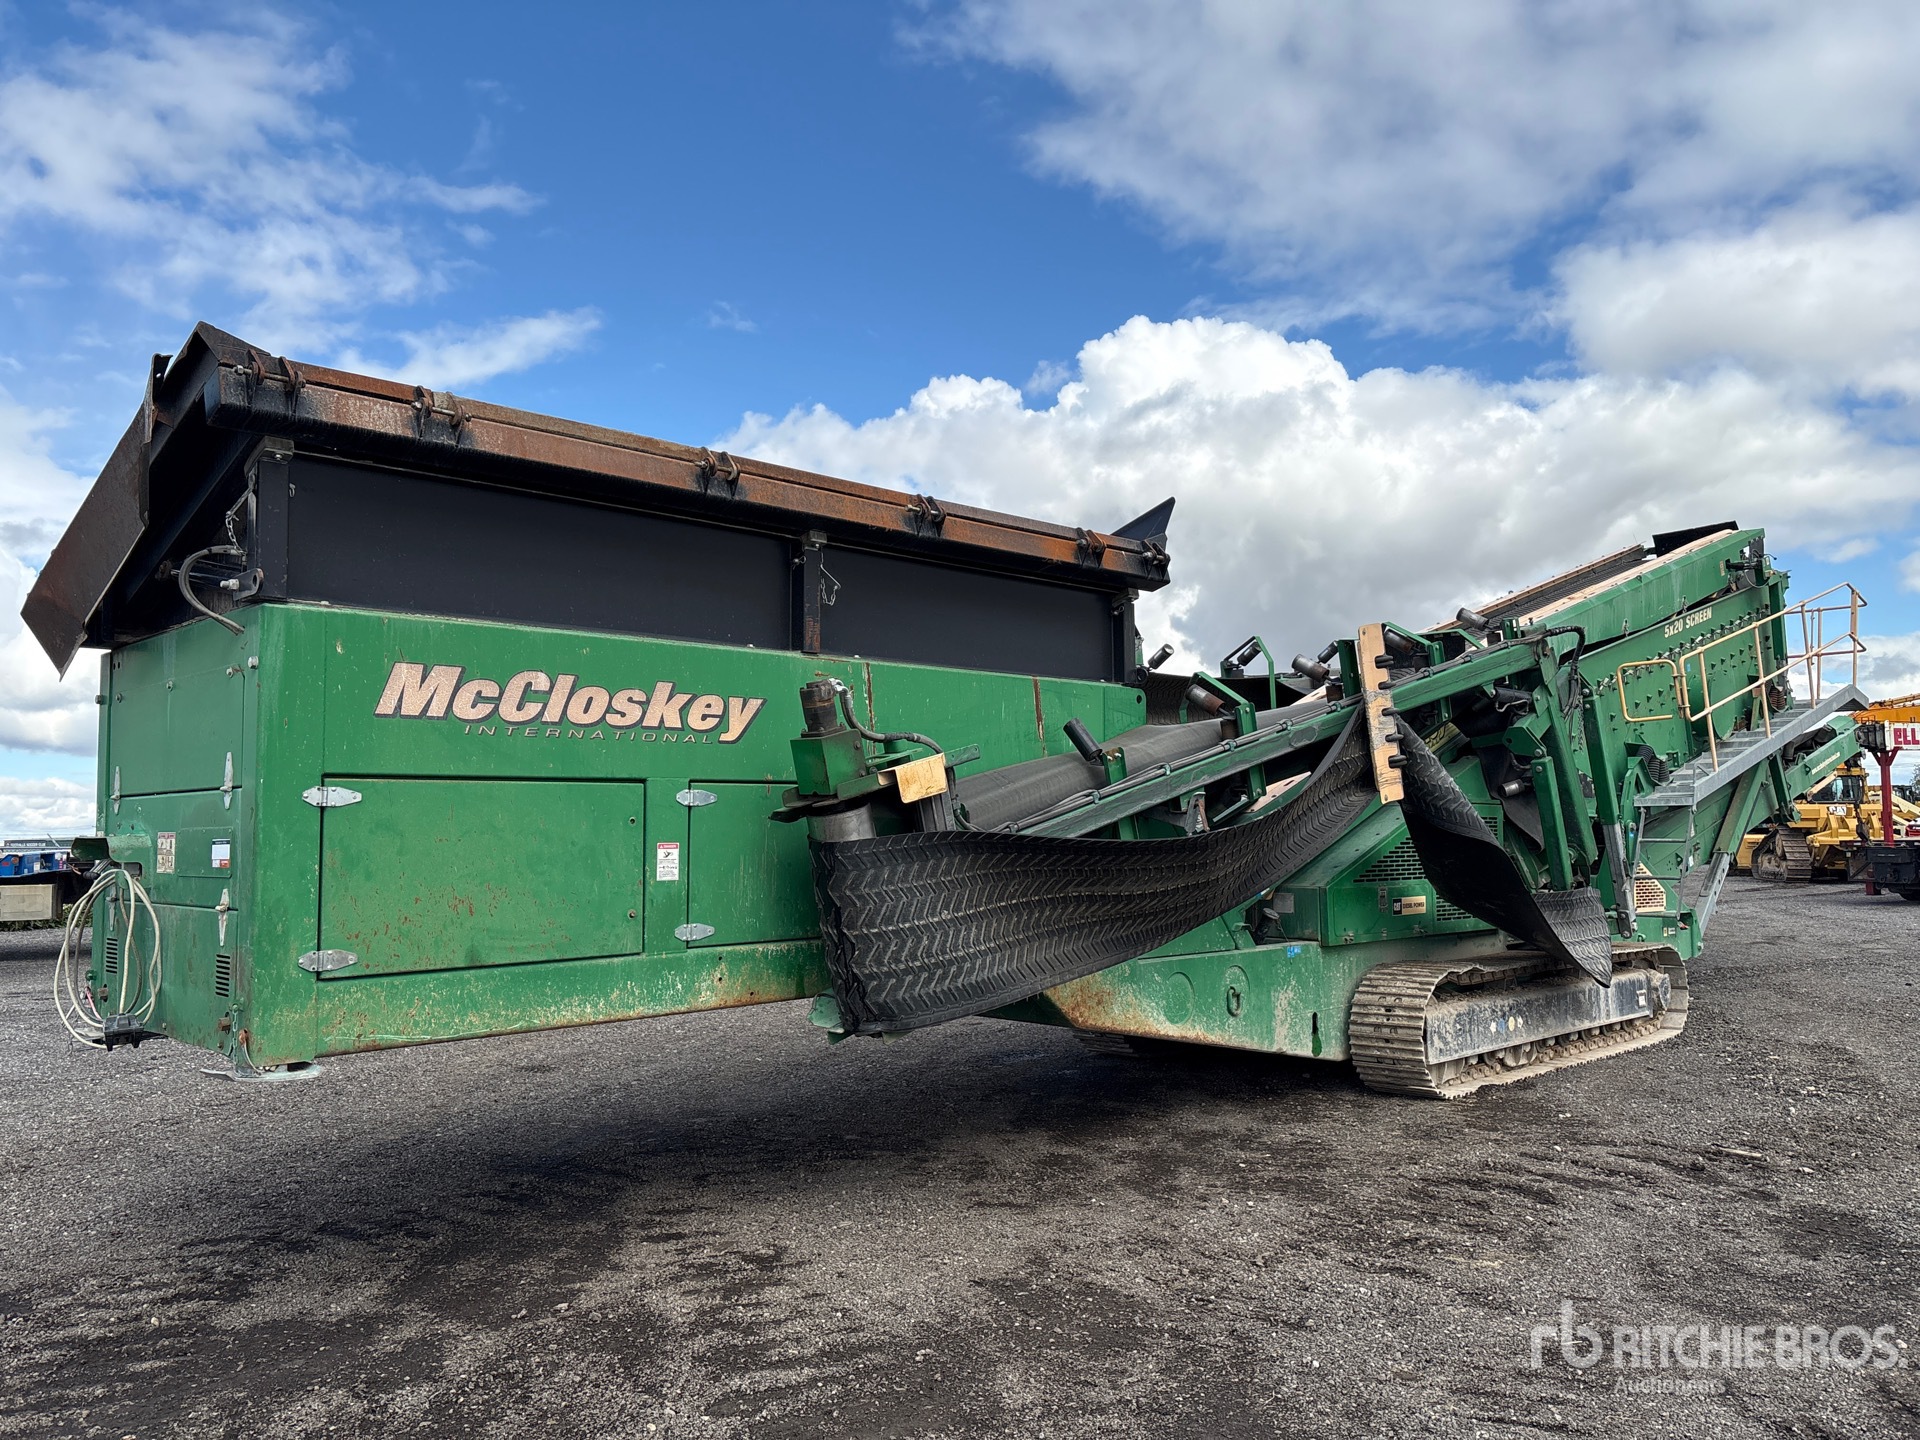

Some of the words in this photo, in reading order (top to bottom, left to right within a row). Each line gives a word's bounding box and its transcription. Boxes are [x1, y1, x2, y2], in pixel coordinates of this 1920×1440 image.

[1664, 618, 1684, 638] 5x20
[1686, 606, 1712, 629] SCREEN
[374, 662, 767, 745] McCloskey
[464, 724, 714, 745] INTERNATIONAL
